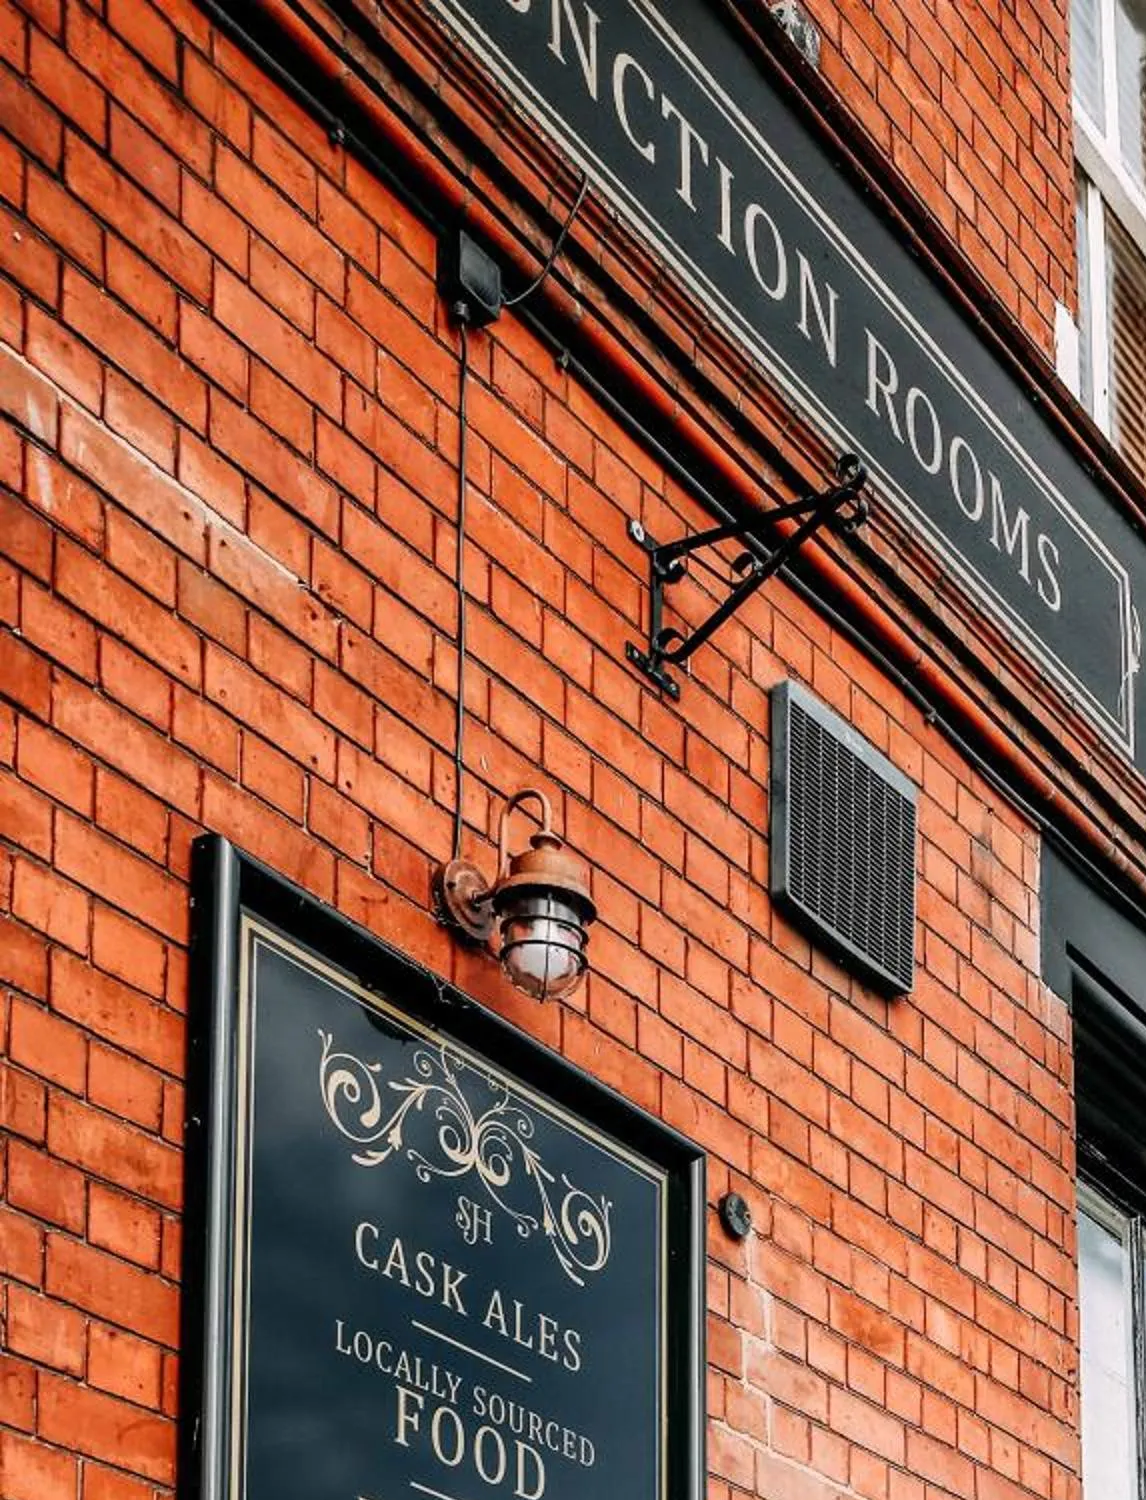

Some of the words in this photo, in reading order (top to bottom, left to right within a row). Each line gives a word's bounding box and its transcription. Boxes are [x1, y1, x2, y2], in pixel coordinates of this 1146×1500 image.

[507, 0, 839, 367] NCTION
[864, 329, 1061, 611] ROOMS
[355, 1222, 468, 1316] CASK
[482, 1290, 582, 1372] ALES
[334, 1319, 463, 1405] LOCALLY
[472, 1386, 595, 1468] SOURCED
